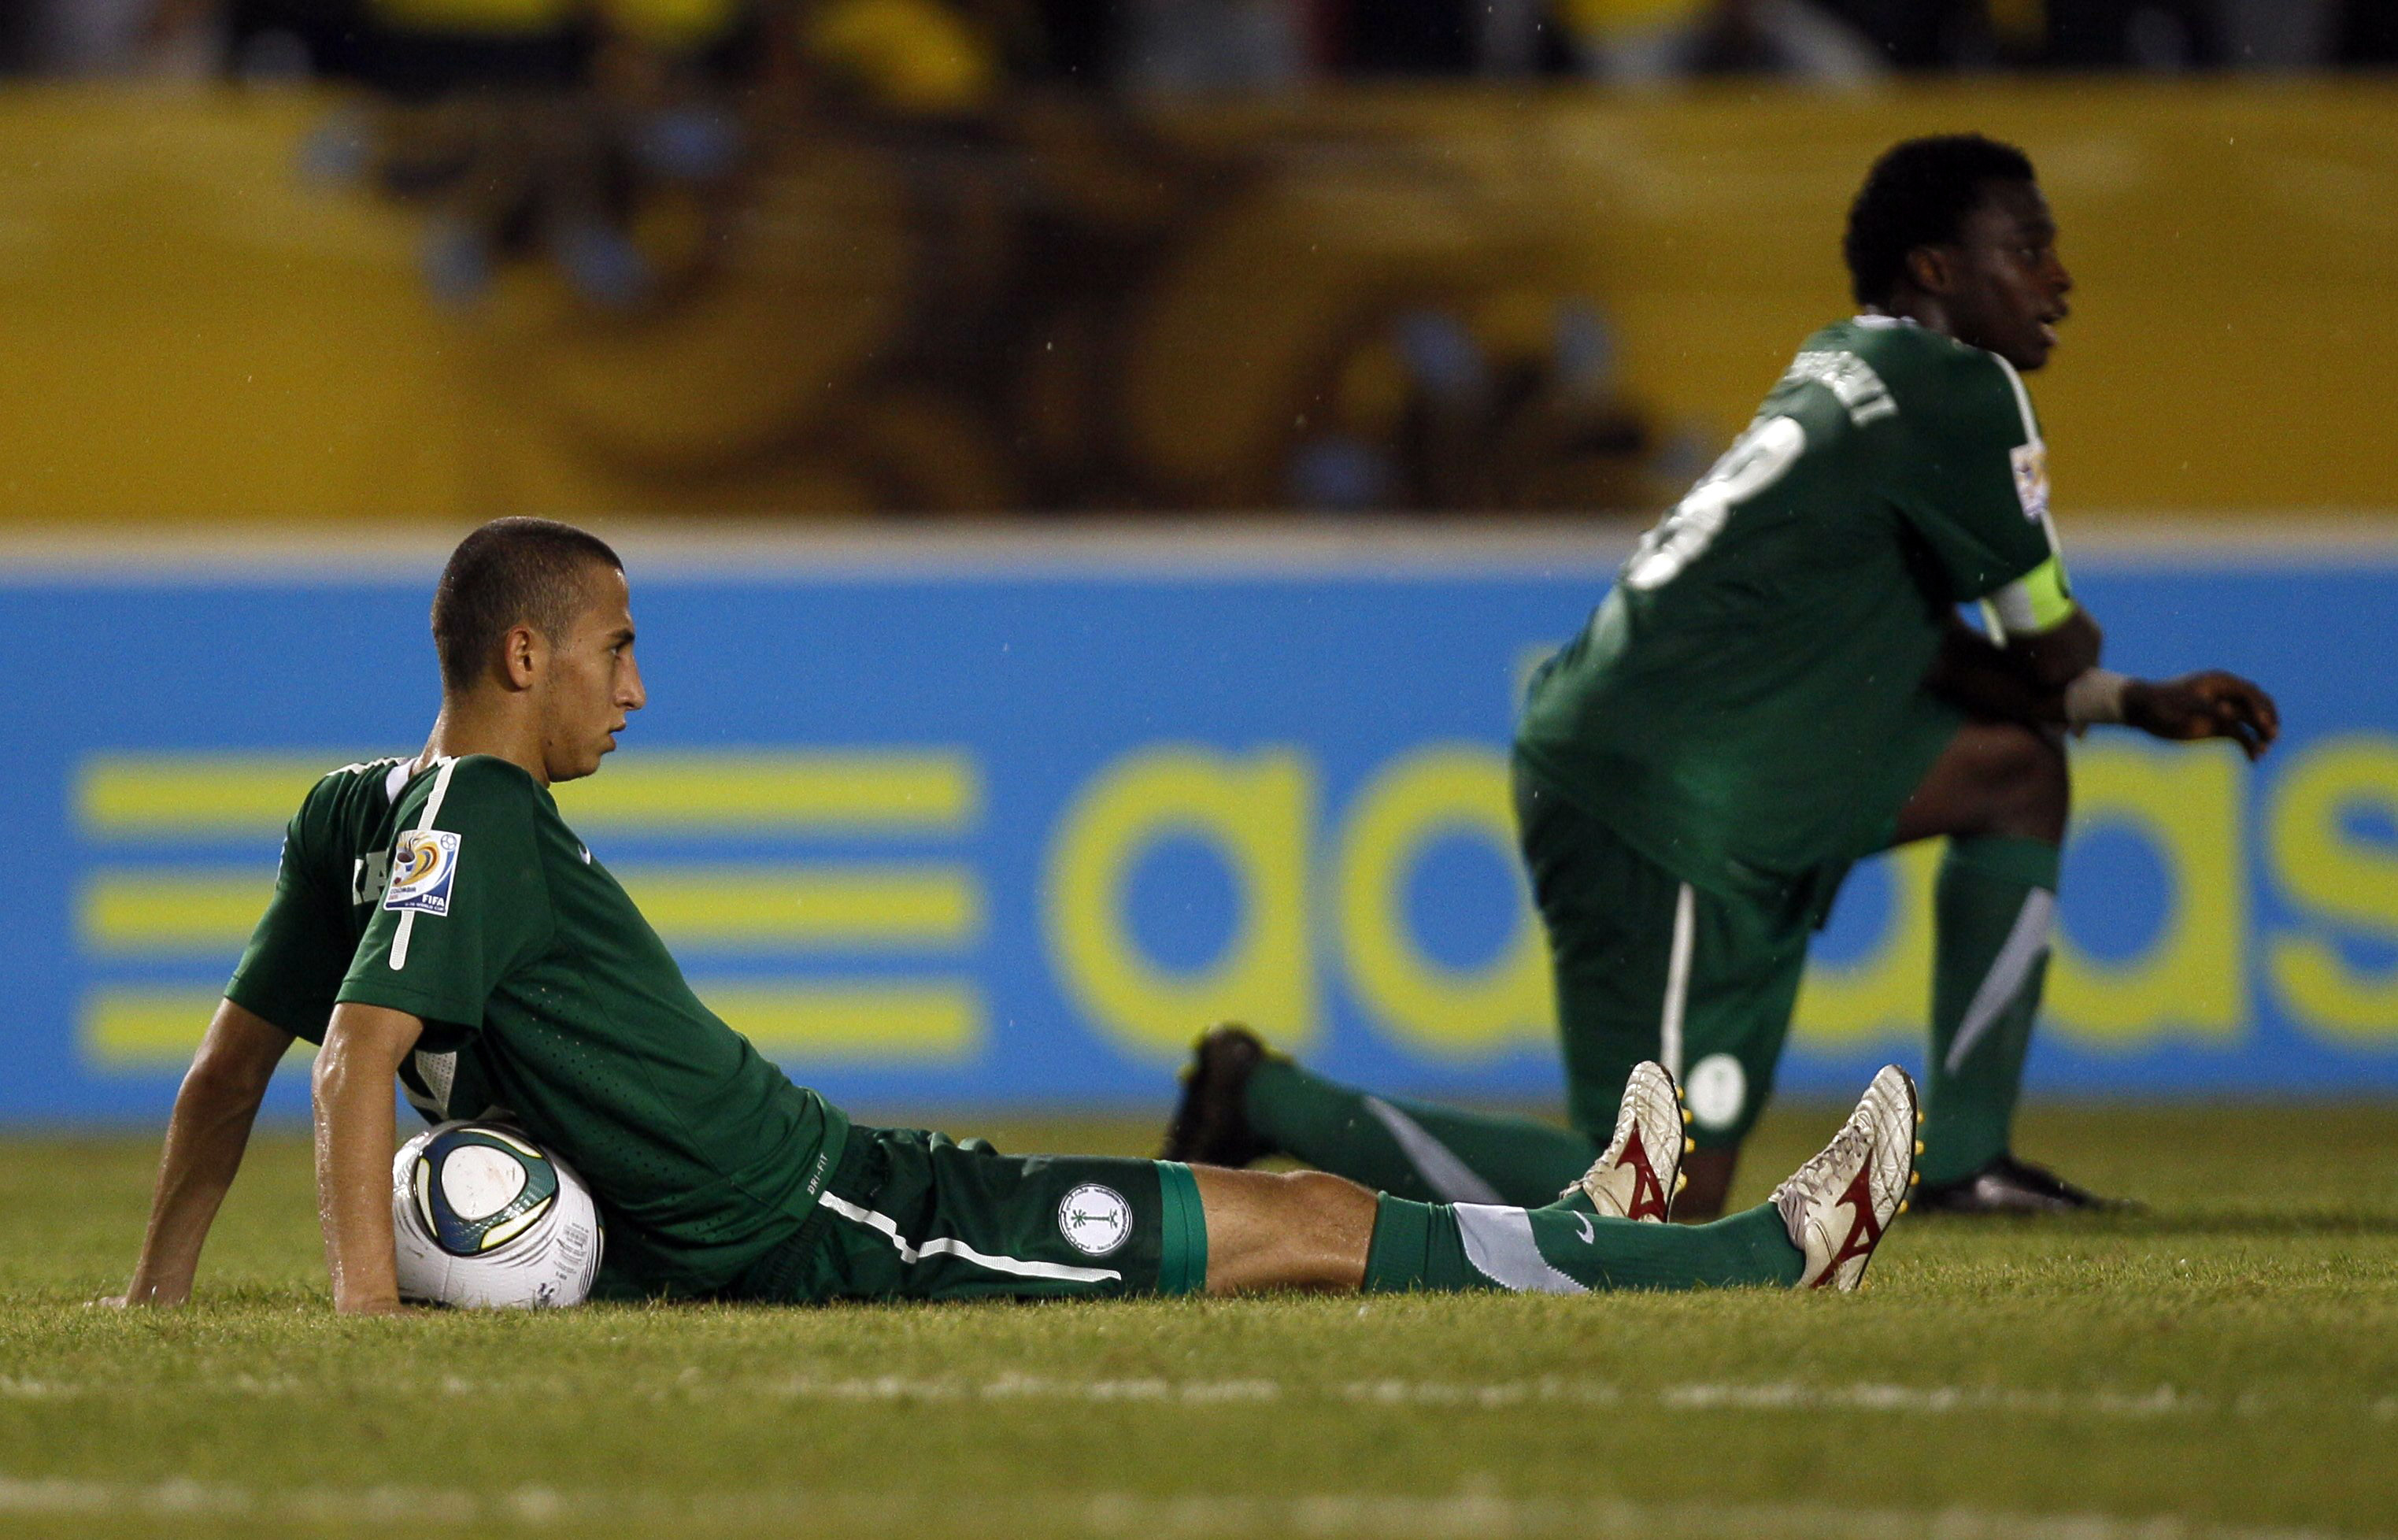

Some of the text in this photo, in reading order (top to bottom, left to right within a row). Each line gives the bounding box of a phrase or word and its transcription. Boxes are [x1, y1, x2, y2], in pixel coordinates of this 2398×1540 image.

[1051, 646, 2398, 1057] adas
[422, 894, 444, 907] FIFA
[807, 1153, 828, 1195] DRI-FIT
